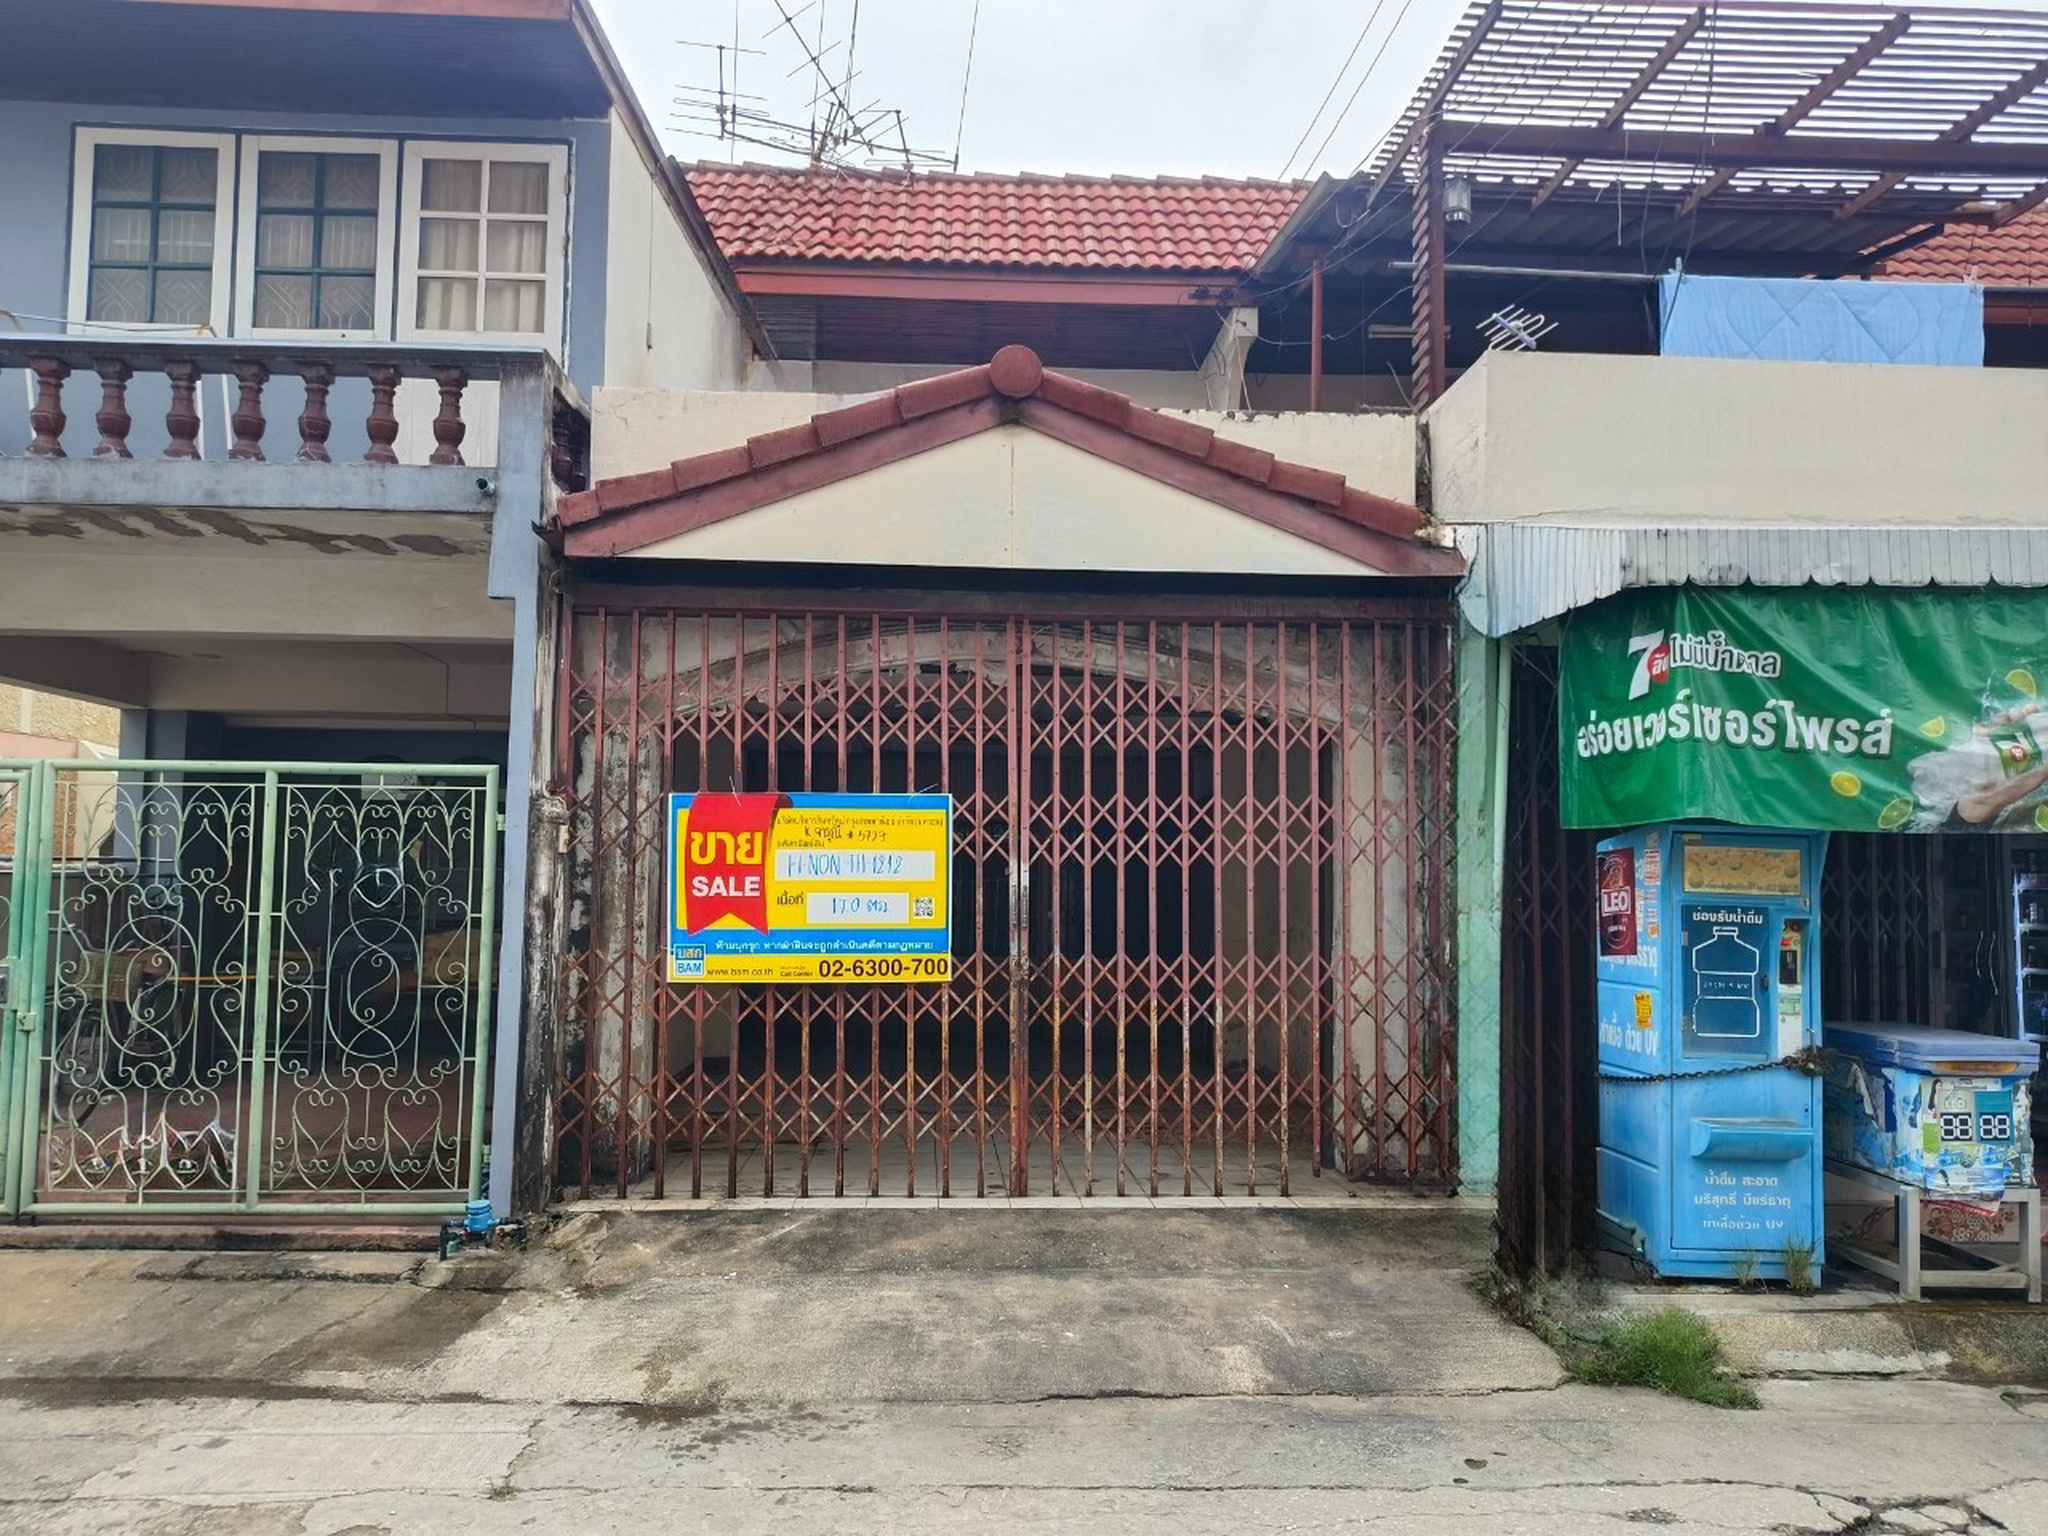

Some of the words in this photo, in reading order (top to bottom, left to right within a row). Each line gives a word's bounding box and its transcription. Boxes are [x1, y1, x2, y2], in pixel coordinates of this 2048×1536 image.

[1628, 629, 1664, 700] 7
[690, 831, 762, 865] ขาย
[692, 877, 760, 897] SALE
[1604, 888, 1629, 913] LEO
[1692, 907, 1763, 925] ช่องรับน้ำดื่ม
[678, 963, 701, 974] BAM
[819, 958, 948, 978] 02-6300-700
